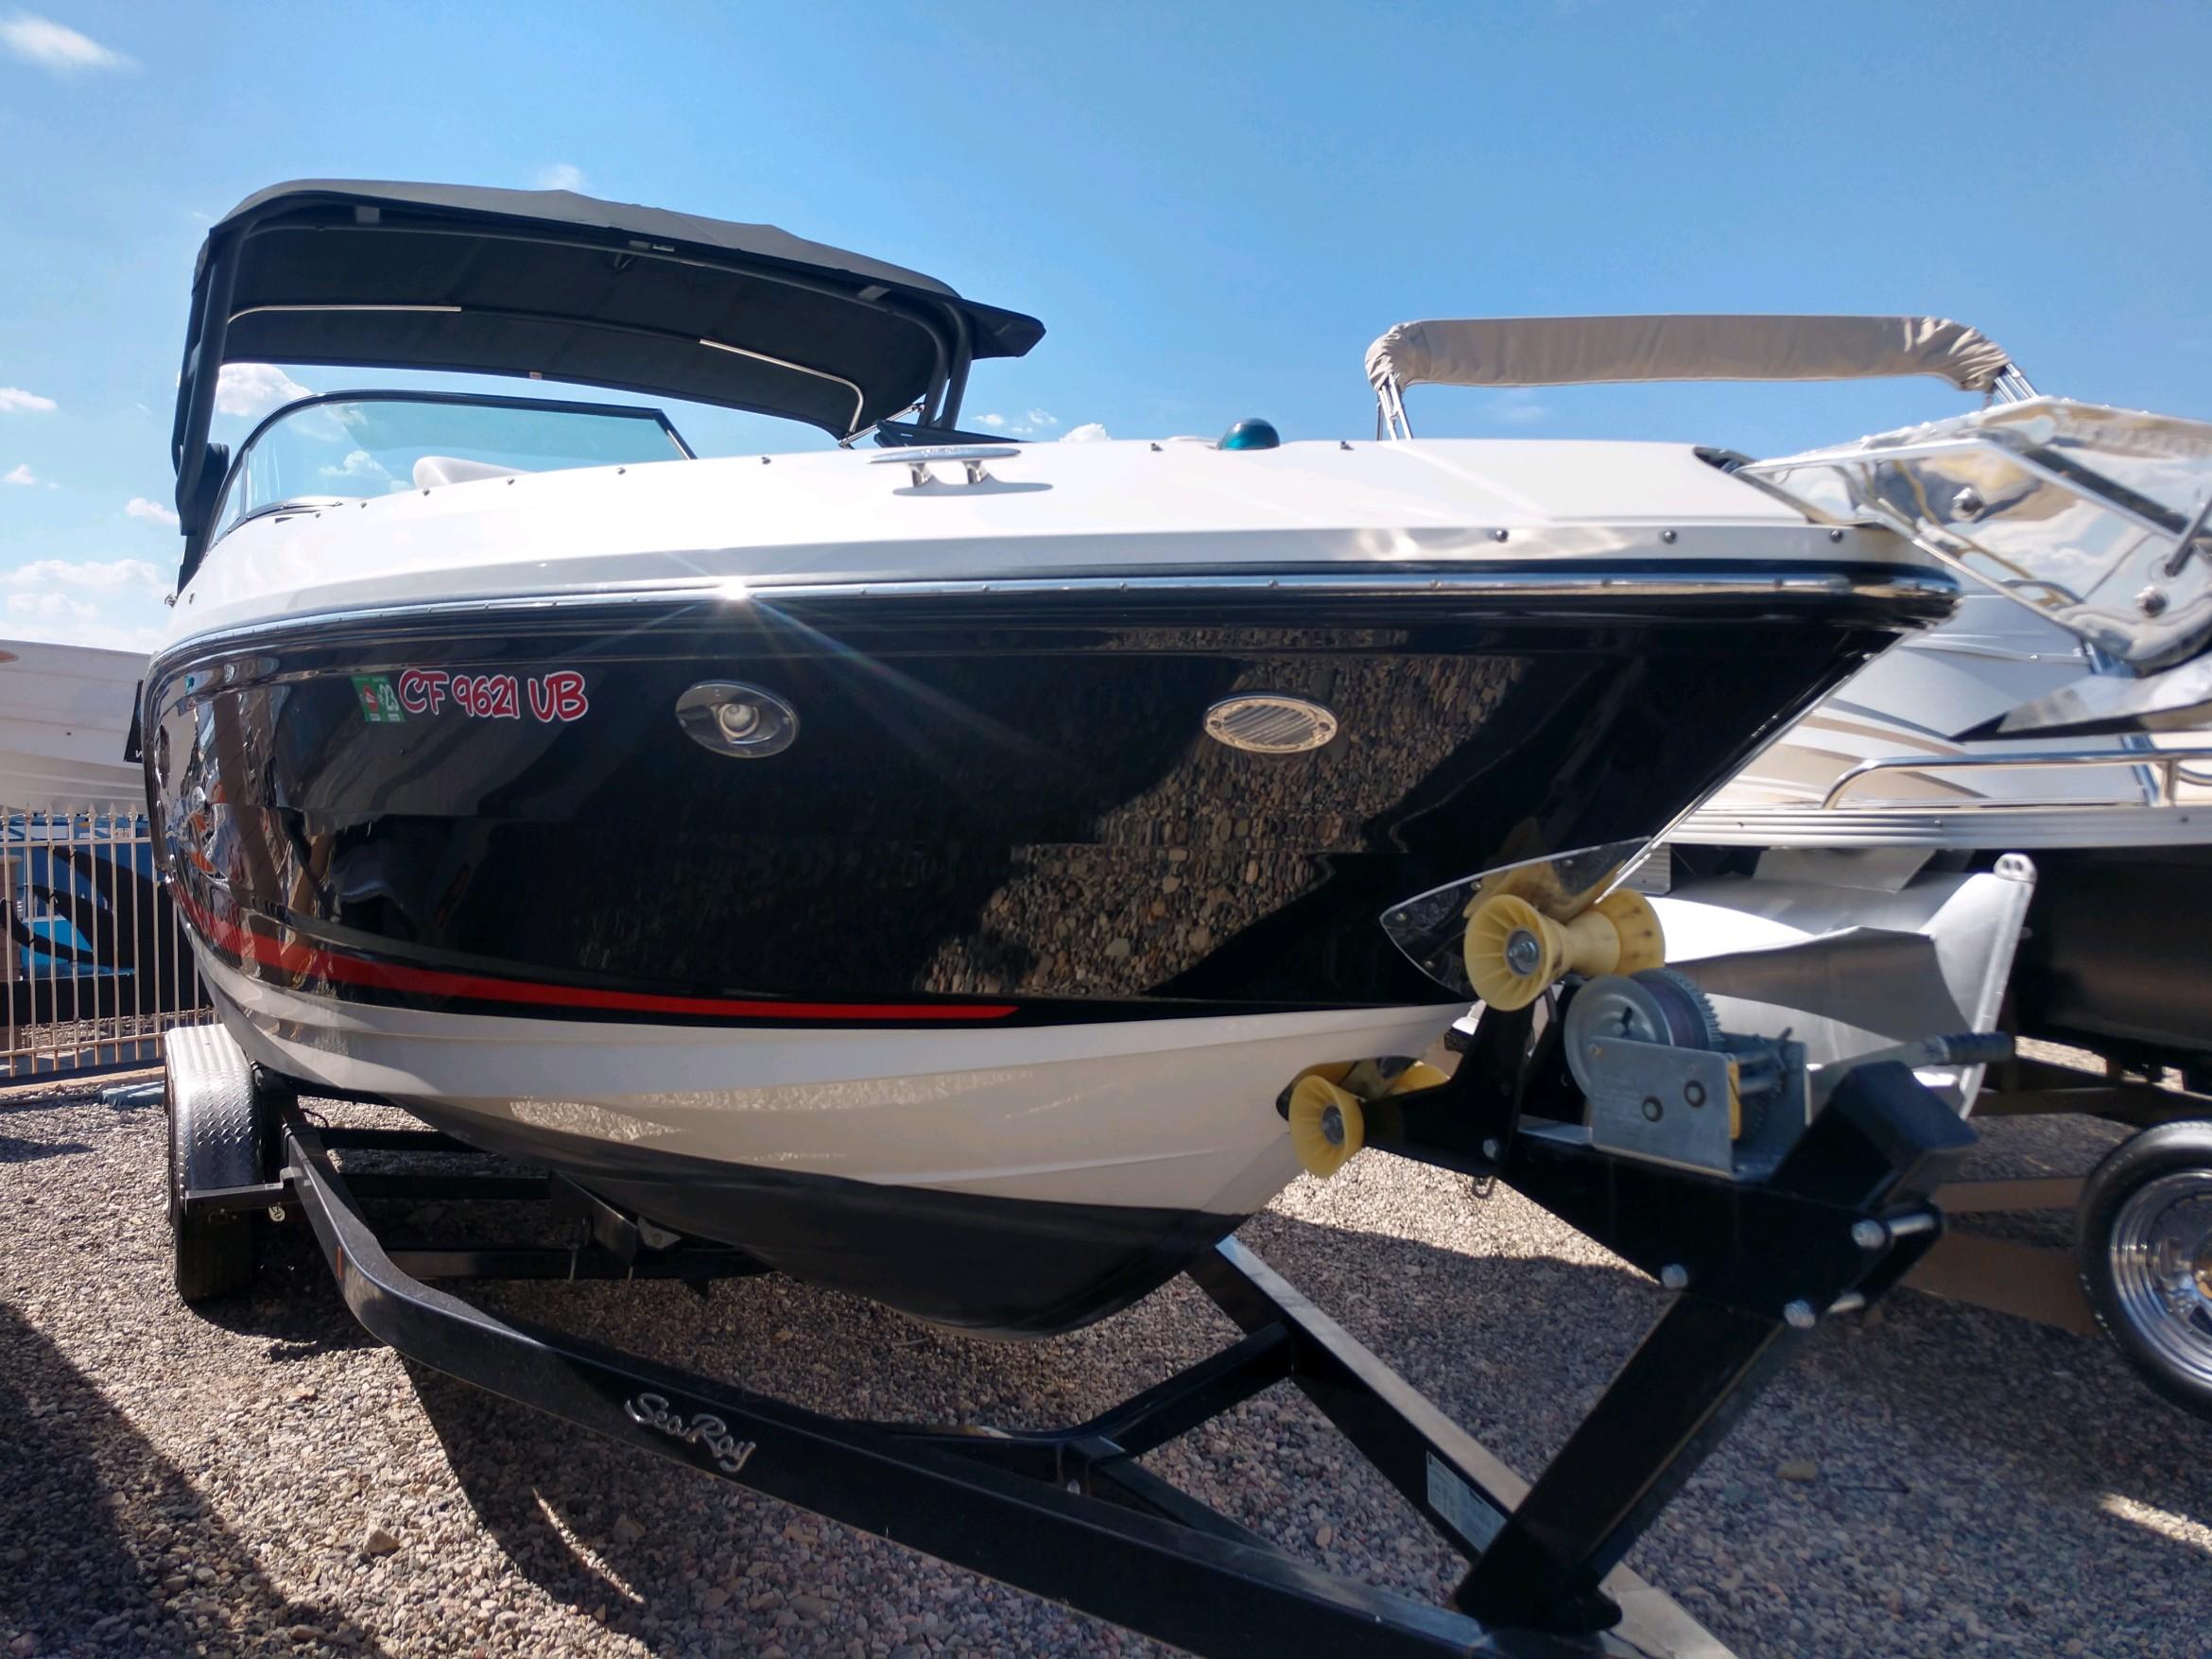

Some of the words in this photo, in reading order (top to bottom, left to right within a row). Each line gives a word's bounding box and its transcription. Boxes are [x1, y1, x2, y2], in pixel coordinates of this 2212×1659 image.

[399, 668, 449, 716] CF
[452, 674, 521, 720] 9621
[527, 670, 589, 722] UB
